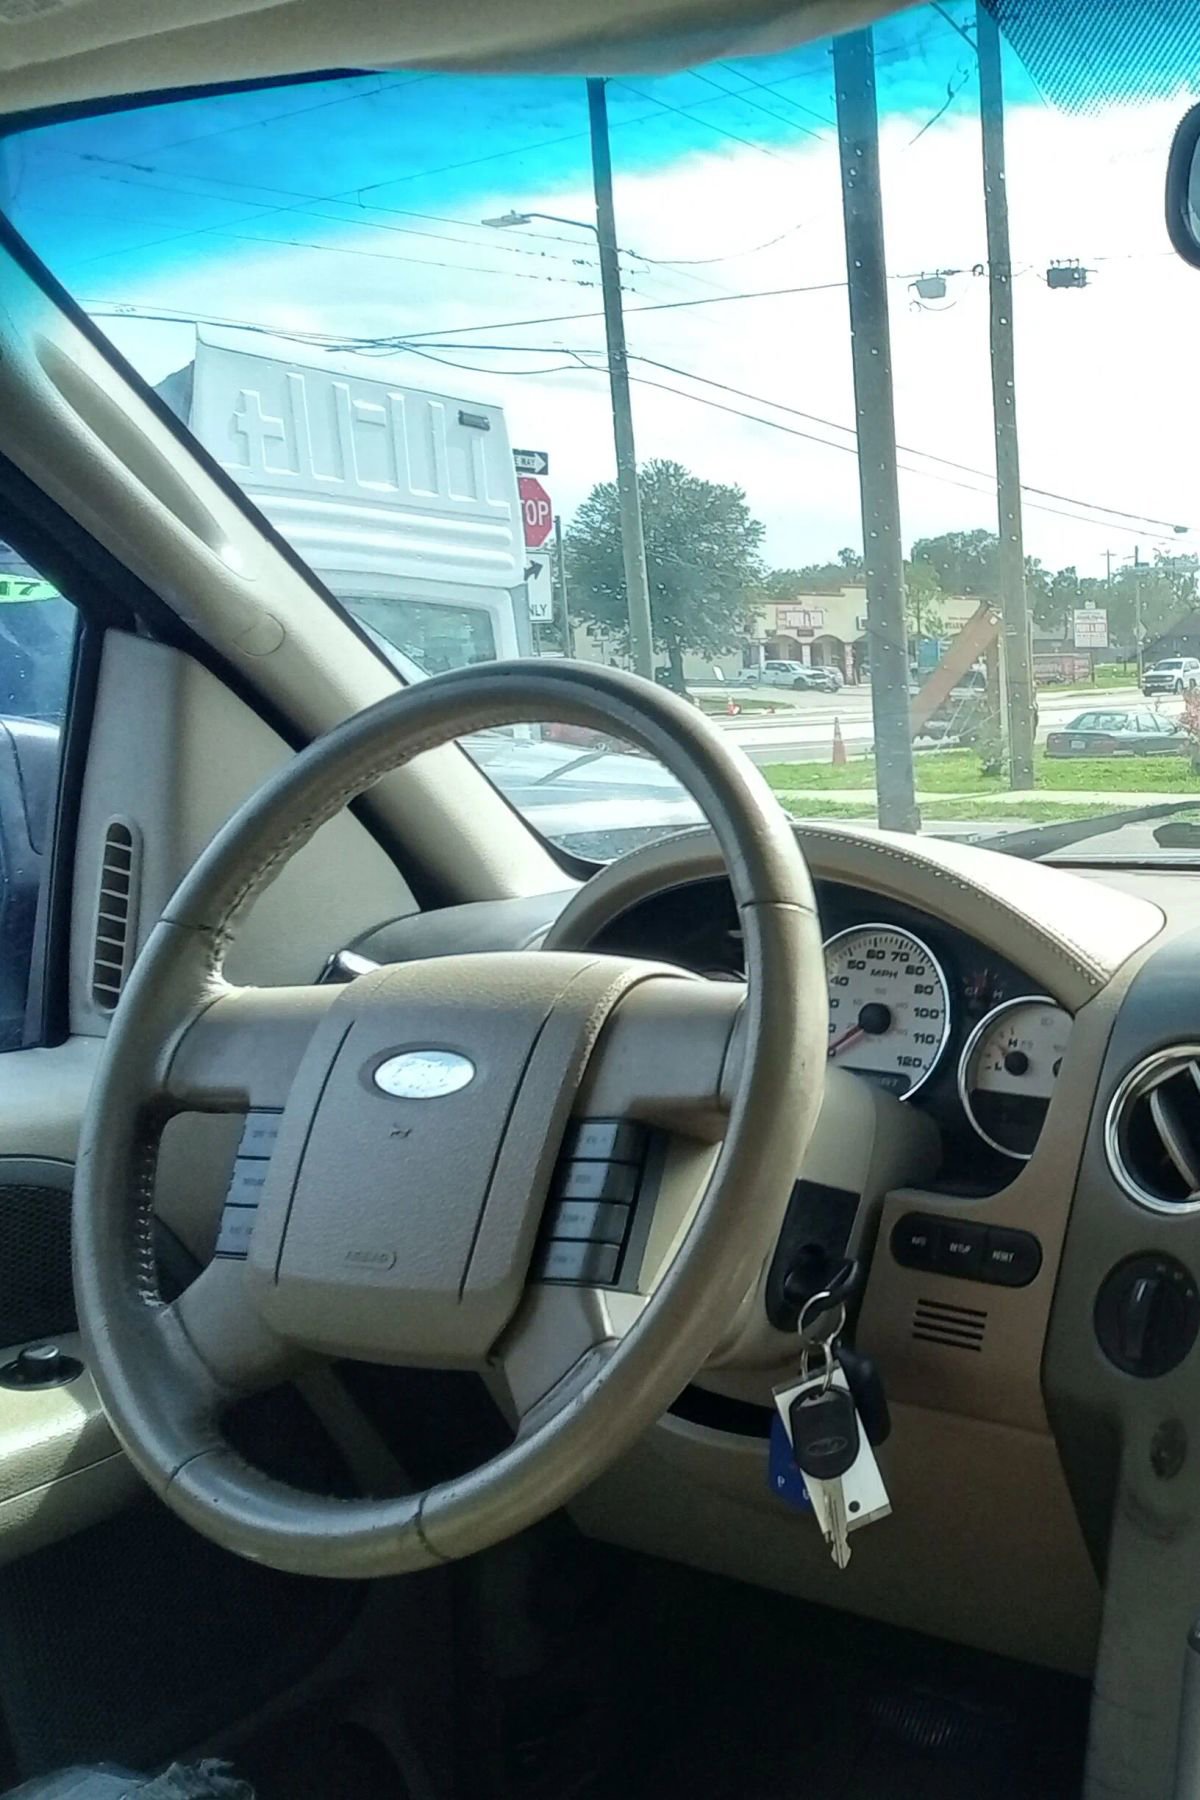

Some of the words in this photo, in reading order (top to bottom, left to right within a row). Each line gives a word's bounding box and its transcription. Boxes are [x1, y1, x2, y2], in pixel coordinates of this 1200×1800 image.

[891, 951, 910, 962] 70
[870, 968, 898, 979] MPH
[830, 976, 849, 986] 40
[914, 1008, 939, 1019] 100
[914, 1033, 935, 1045] 110
[897, 1056, 922, 1068] 120
